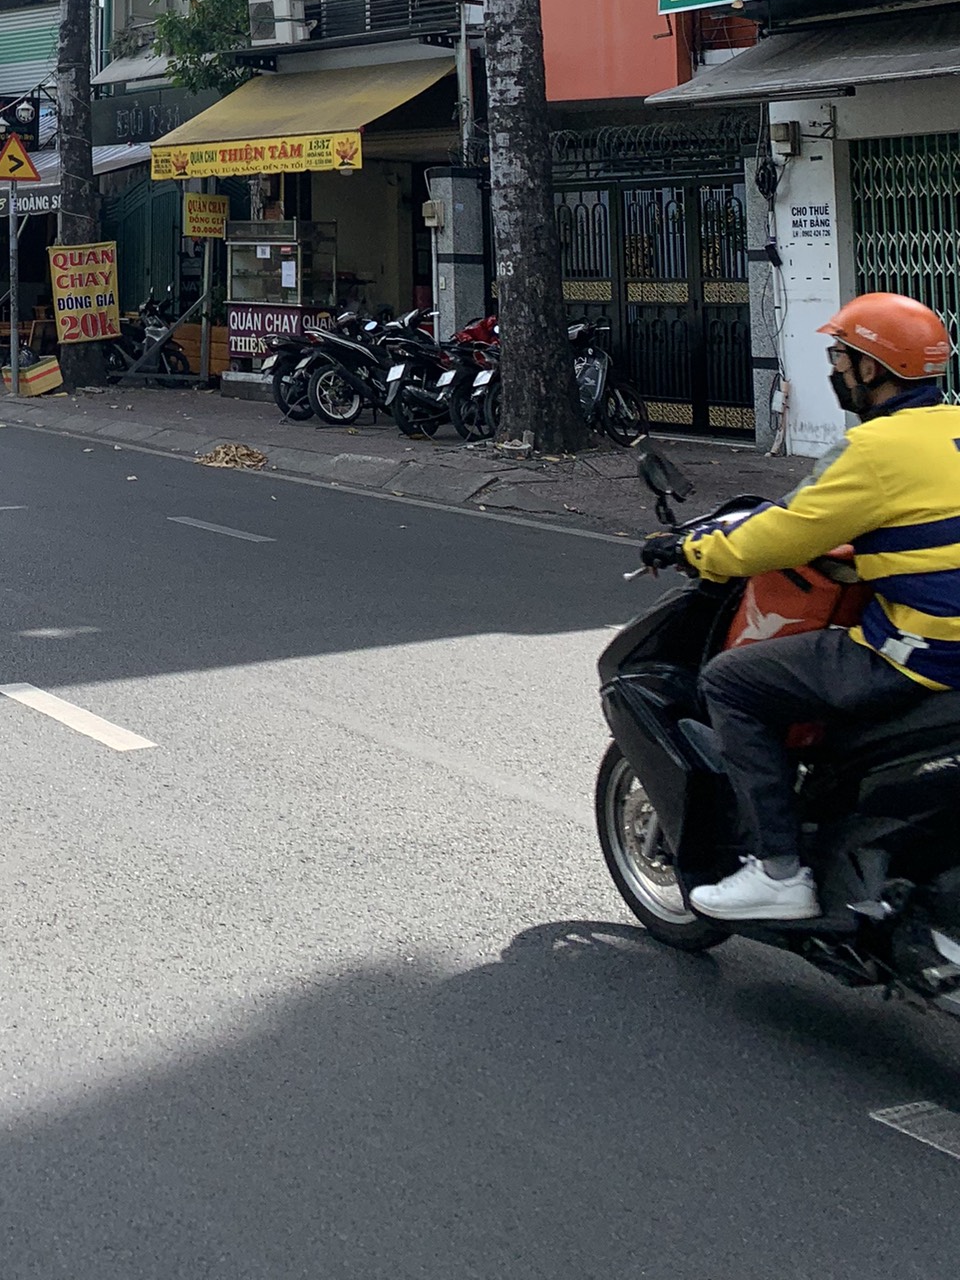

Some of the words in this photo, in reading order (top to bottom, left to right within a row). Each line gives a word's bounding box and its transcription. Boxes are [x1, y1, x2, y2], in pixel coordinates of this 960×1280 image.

[219, 144, 265, 165] THIỆN
[267, 140, 304, 160] TÂM
[308, 139, 331, 151] 1337
[791, 206, 807, 216] CHO
[809, 203, 830, 216] THUÊ
[810, 216, 830, 228] BẰNG
[56, 270, 113, 289] CHAY
[230, 308, 262, 331] QUÁN
[265, 313, 298, 334] CHAY
